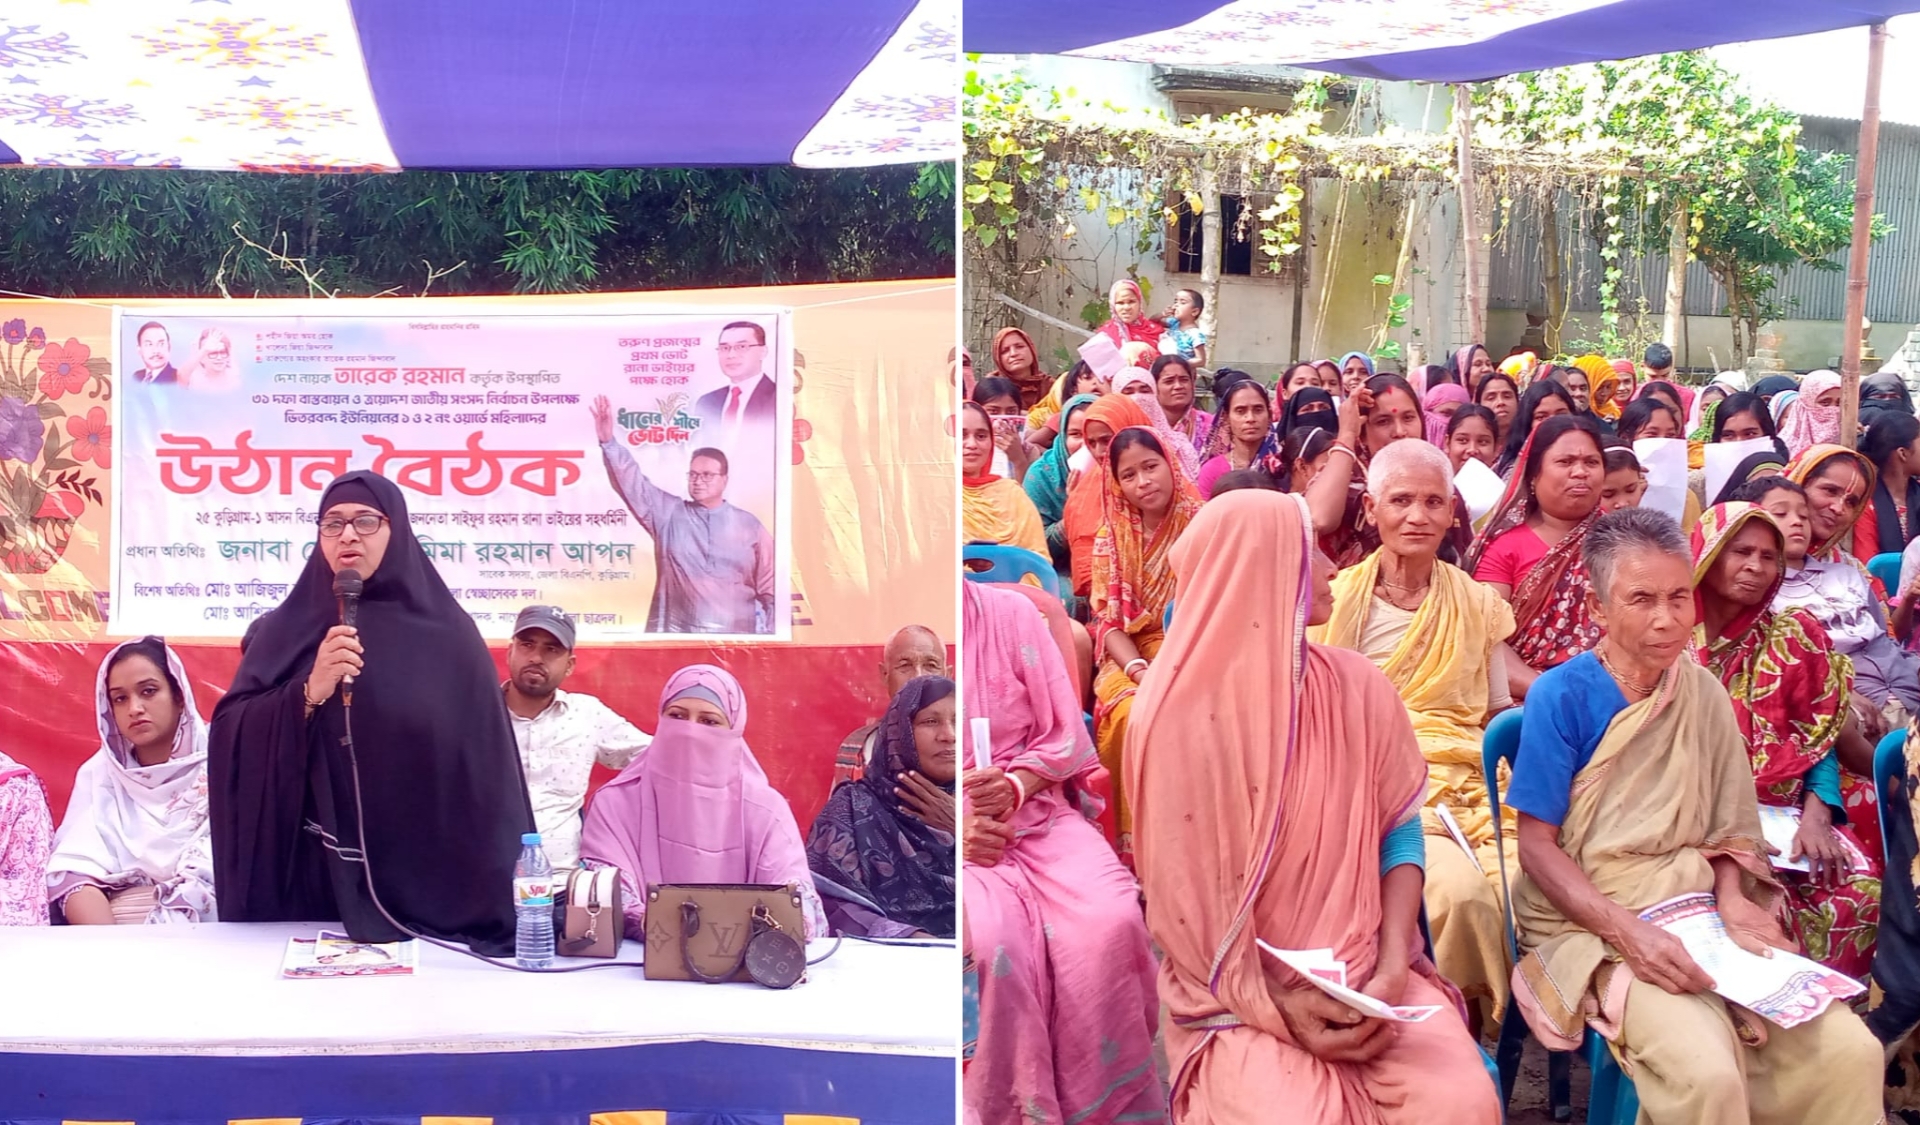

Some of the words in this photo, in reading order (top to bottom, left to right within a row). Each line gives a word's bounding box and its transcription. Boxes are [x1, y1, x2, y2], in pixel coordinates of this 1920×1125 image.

[618, 337, 651, 348] তরুণ
[653, 336, 701, 348] প্রজন্মের
[631, 350, 659, 361] প্রথম
[661, 348, 689, 360] ভোট
[623, 363, 649, 373] রানা
[651, 361, 696, 373] ভাইয়ের
[274, 373, 297, 384] দেশ
[299, 373, 333, 385] নায়ক
[334, 367, 398, 386] তারেক
[401, 367, 466, 386] রহমান
[469, 370, 504, 388] কর্তৃক
[506, 369, 562, 386] উপস্থাপিত
[629, 375, 659, 385] পক্ষে
[661, 375, 690, 386] হোক
[252, 394, 270, 405] ৩১
[272, 393, 297, 405] দফা
[299, 393, 350, 406] বাস্তবায়ন
[352, 394, 362, 405] ও
[364, 393, 409, 406] ত্রয়োদশ
[411, 390, 449, 406] জাতীয়
[450, 394, 484, 405] সংসদ
[486, 390, 528, 405] নির্বাচন
[530, 391, 580, 405] উপলক্ষে
[284, 408, 338, 424] ভিতরবন্দ
[340, 410, 399, 424] ইউনিয়নের
[401, 414, 410, 424] ১
[412, 413, 422, 424] ও
[424, 413, 432, 424] ২
[434, 413, 450, 424] নং
[452, 409, 488, 424] ওয়ার্ডে
[490, 409, 547, 425] মহিলাদের
[617, 407, 663, 430] ধানের
[673, 409, 701, 429] শীষে
[628, 426, 665, 446] ভোট
[666, 426, 690, 443] দিন
[156, 430, 352, 496] উঠান
[361, 430, 585, 497] বৈঠক
[196, 511, 210, 525] ২৫
[214, 508, 262, 526] কুড়িগ্রাম-১
[265, 510, 292, 524] আসন
[409, 512, 448, 525] জননেতা
[451, 509, 485, 530] সাইফুর
[488, 512, 519, 528] রহমান
[522, 512, 542, 526] রানা
[544, 509, 583, 528] ভাইয়ের
[585, 508, 628, 528] সহধর্মিনী
[126, 545, 157, 559] প্রধান
[161, 542, 206, 559] অতিথিঃ
[217, 538, 293, 563] জনাবা
[473, 540, 554, 566] রহমান
[561, 540, 635, 565] আপন
[479, 569, 506, 580] সাবেক
[536, 569, 559, 580] জেলা
[560, 568, 595, 582] বিএনপি,
[134, 583, 163, 598] বিশেষ
[165, 583, 200, 598] অতিথিঃ
[204, 583, 231, 598] মোঃ
[234, 578, 289, 601] আজিজুল
[465, 587, 518, 601] স্বেচ্ছাসেবক
[203, 606, 229, 620] মোঃ
